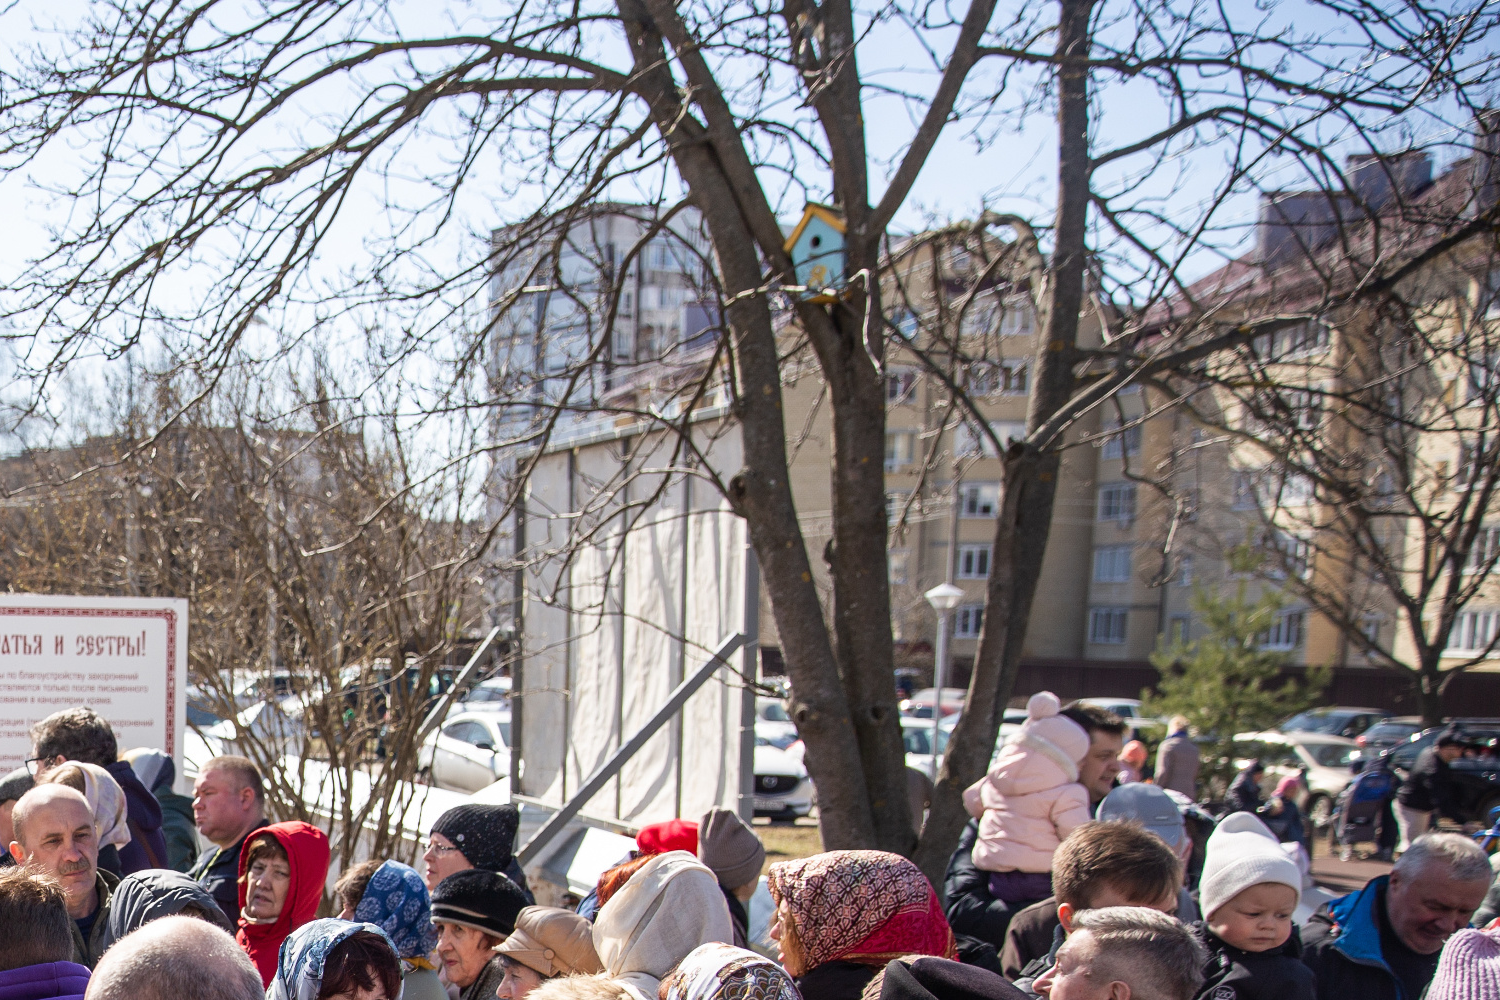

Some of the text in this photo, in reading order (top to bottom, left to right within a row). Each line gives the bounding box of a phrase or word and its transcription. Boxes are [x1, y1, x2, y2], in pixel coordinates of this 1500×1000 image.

[54, 635, 64, 655] и
[76, 630, 146, 657] сестры!
[6, 672, 17, 680] по
[18, 670, 86, 682] благоустройству
[87, 671, 139, 682] захоронений
[43, 684, 70, 693] только
[72, 684, 96, 693] после
[97, 684, 149, 694] письменного
[30, 696, 35, 704] в
[37, 696, 84, 706] канцелярии
